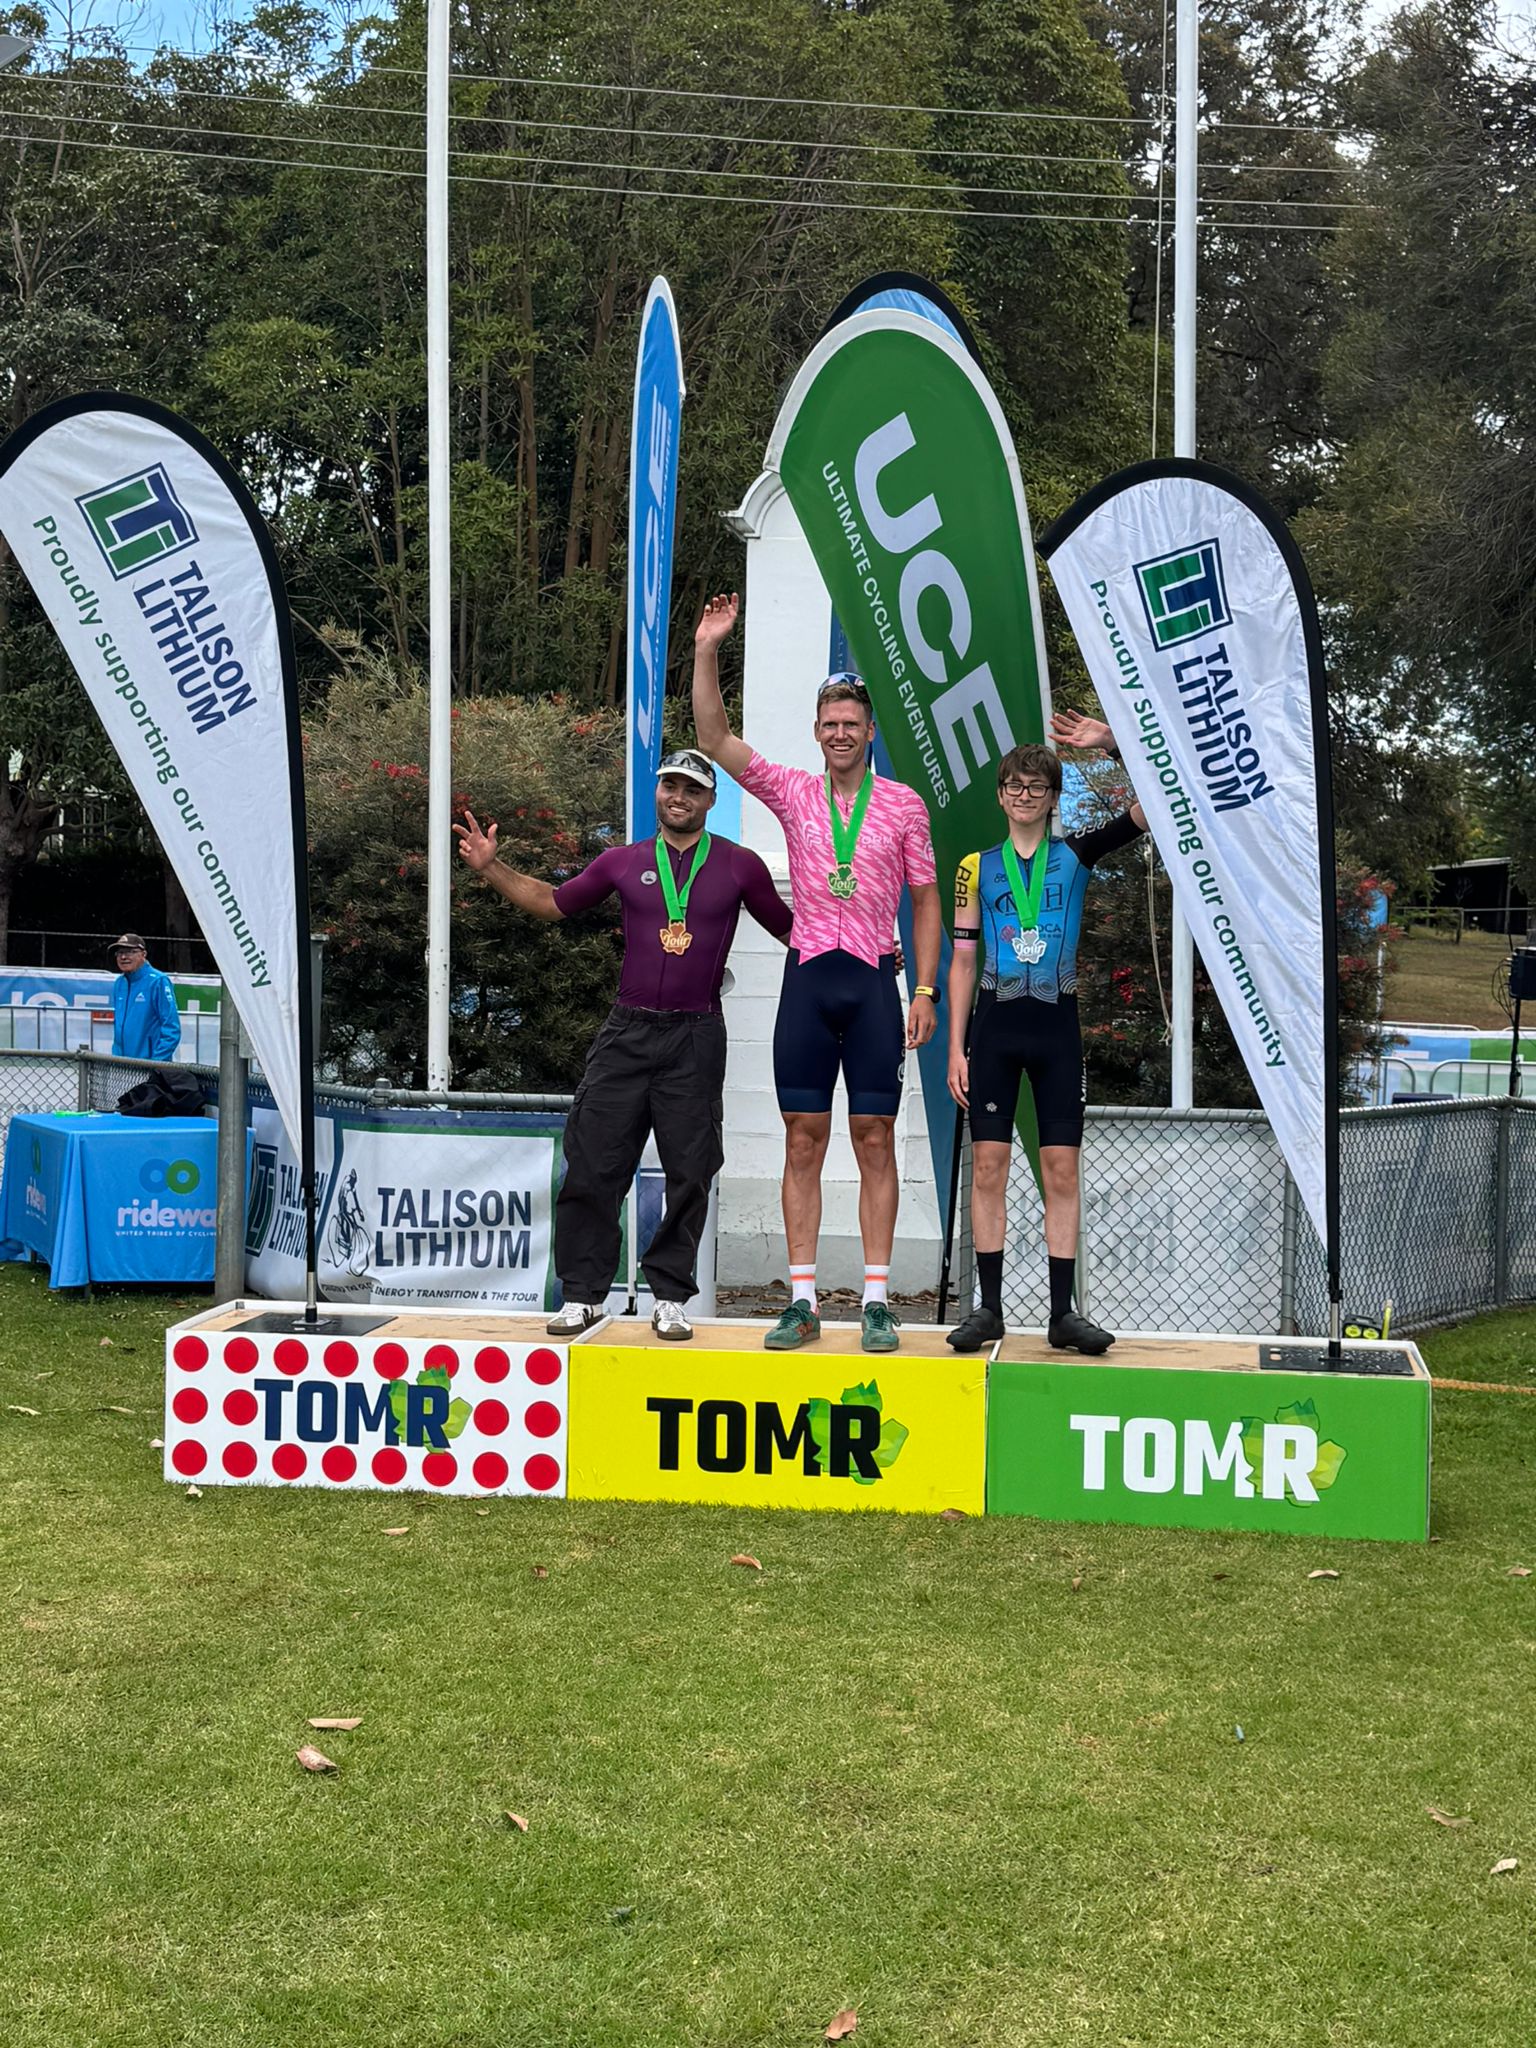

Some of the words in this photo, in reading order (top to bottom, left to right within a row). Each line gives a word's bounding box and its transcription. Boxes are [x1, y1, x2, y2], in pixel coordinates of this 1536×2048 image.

[134, 578, 227, 735] LITHIUM
[169, 560, 258, 717] TALISON
[822, 460, 872, 577] ULTIMATE
[863, 576, 906, 681] CYCLING
[898, 680, 951, 809] EVENTURES
[854, 411, 1016, 793] UCE
[32, 515, 103, 626] Proudly
[95, 632, 180, 785] supporting
[173, 787, 205, 832] our
[198, 839, 272, 989] community
[1173, 655, 1253, 813] LITHIUM
[1205, 642, 1275, 801] TALISON
[1090, 579, 1144, 690] Proudly
[1134, 698, 1204, 856] supporting
[1192, 859, 1224, 906] our
[1213, 914, 1286, 1068] community
[375, 1230, 531, 1269] LITHIUM
[377, 1187, 532, 1228] TALISON
[416, 1289, 478, 1300] TRANSITION
[480, 1290, 488, 1300] &
[491, 1291, 508, 1301] THE
[511, 1292, 539, 1302] TOUR
